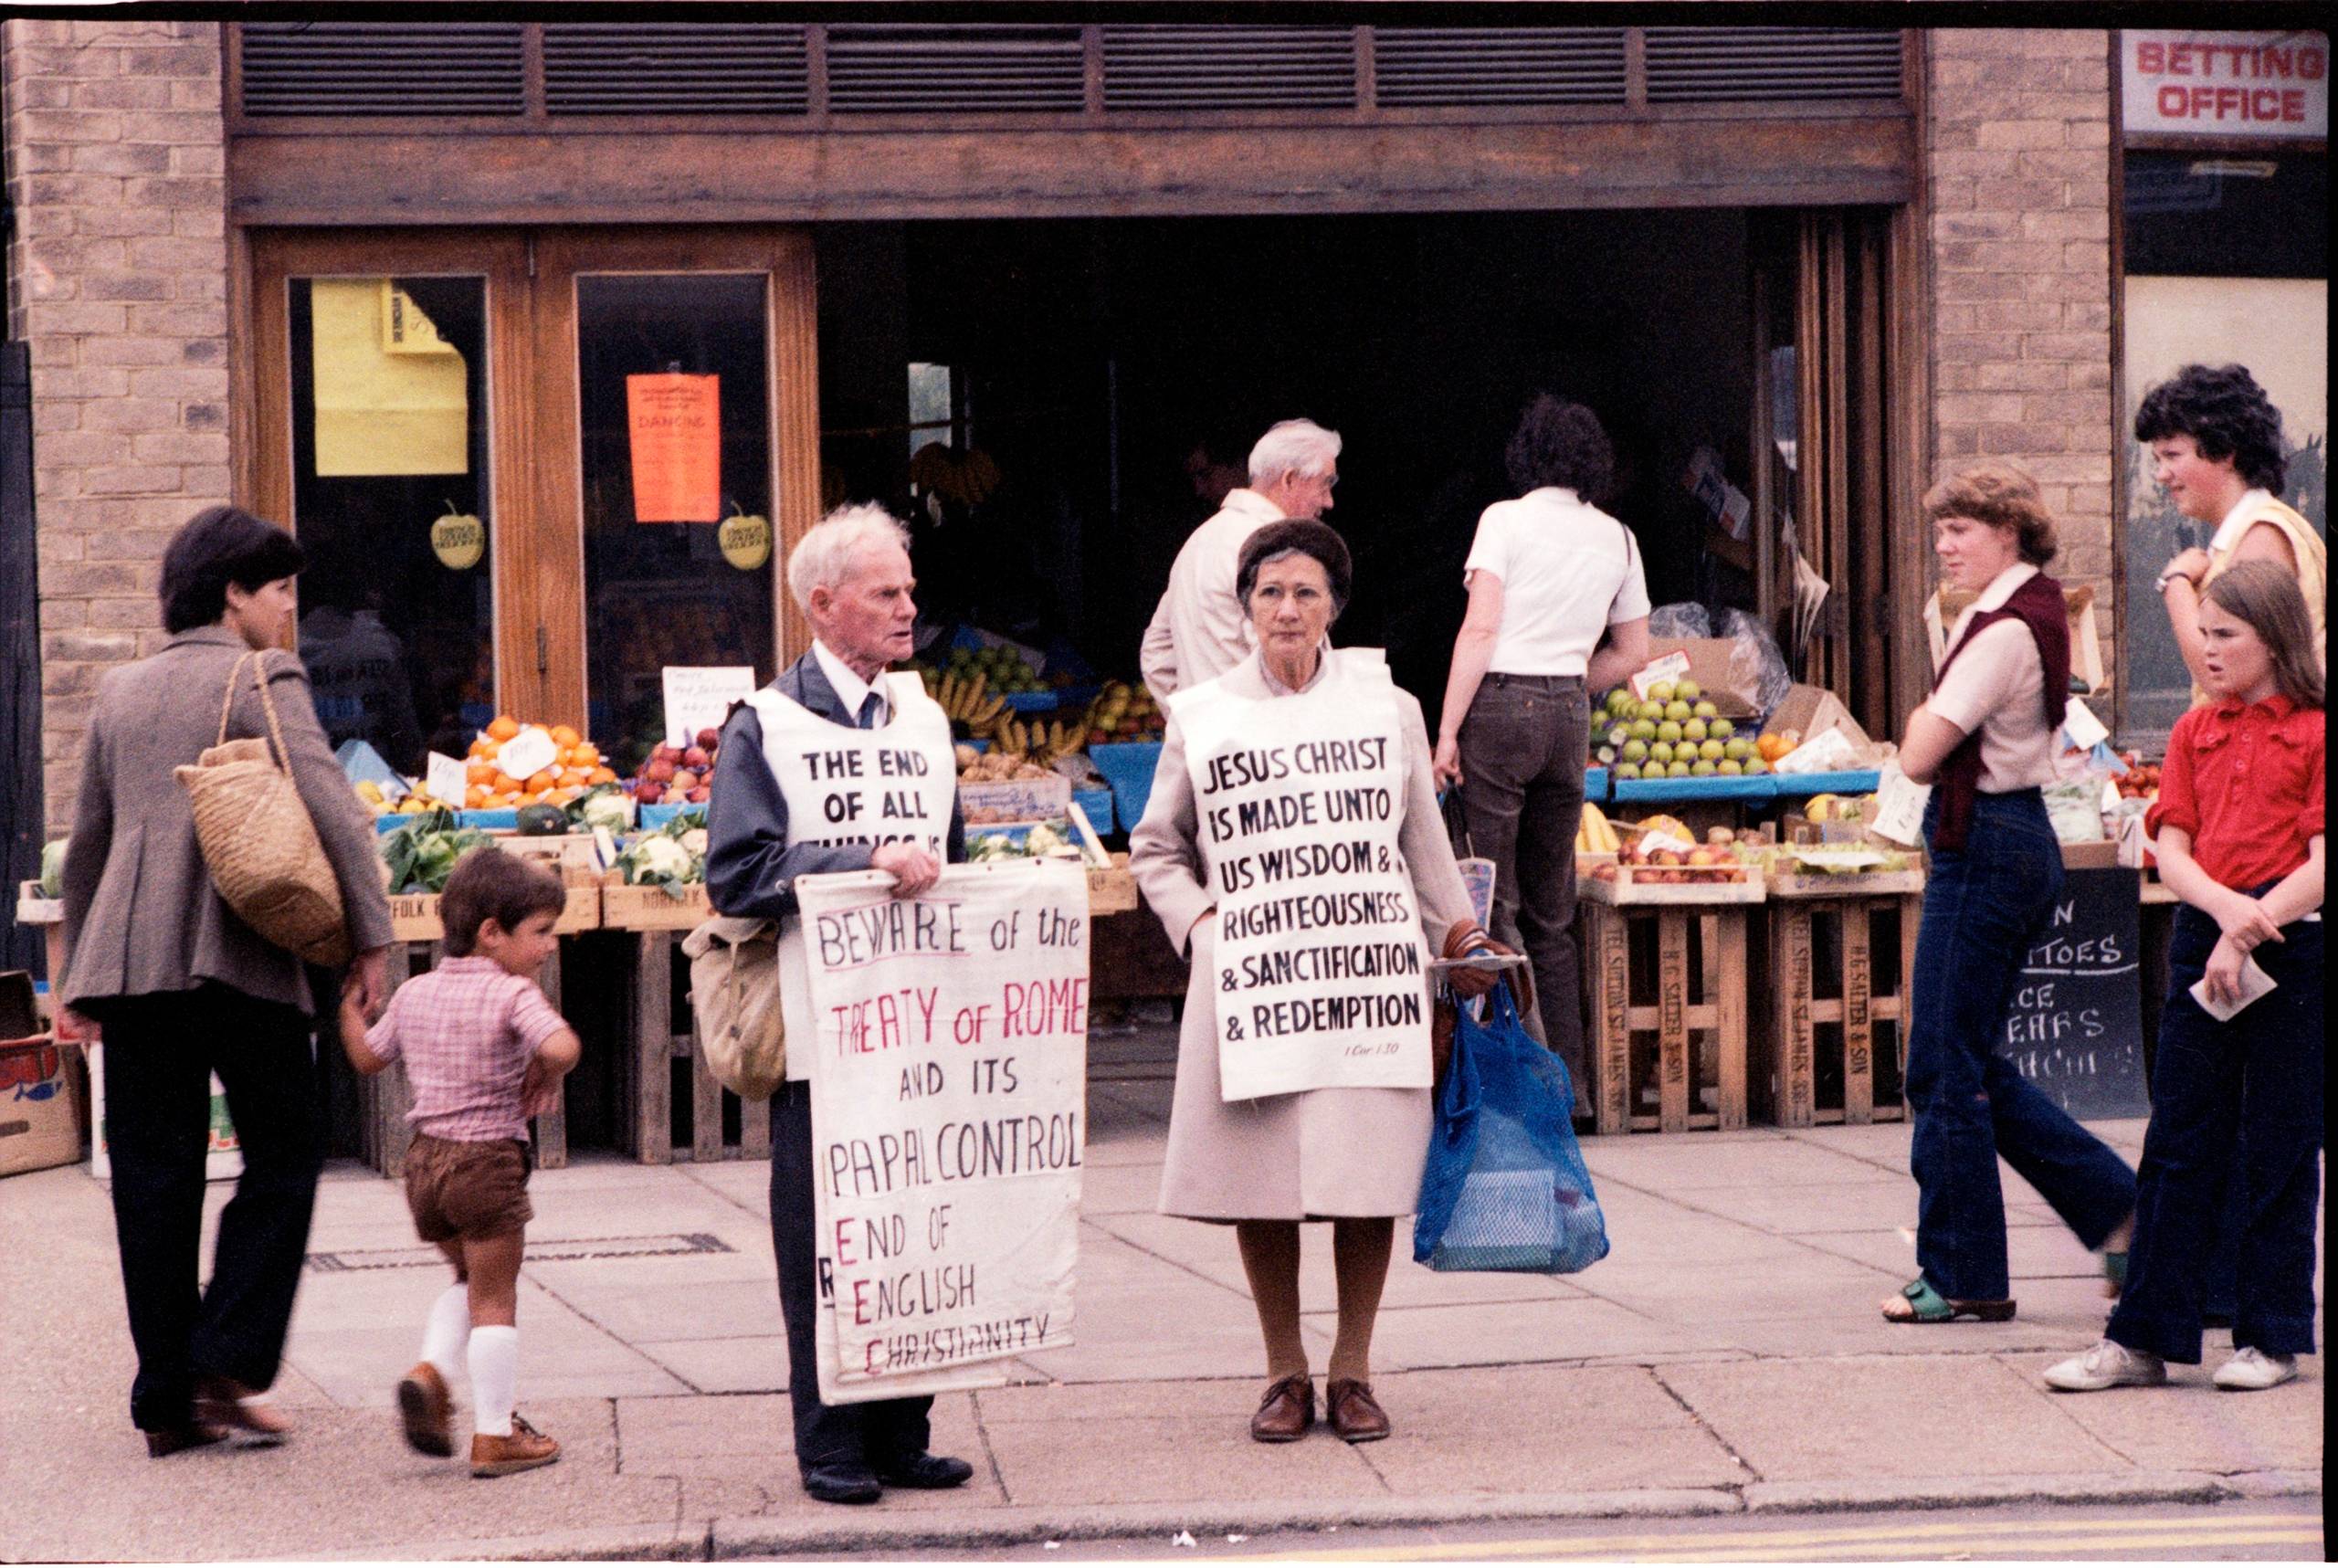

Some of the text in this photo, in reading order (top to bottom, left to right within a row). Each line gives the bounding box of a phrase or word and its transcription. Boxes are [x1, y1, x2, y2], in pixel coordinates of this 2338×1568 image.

[2136, 42, 2326, 80] BETTING
[2157, 85, 2306, 122] OFFICE
[802, 749, 928, 781] THE END
[1203, 737, 1387, 795] JESUS CHRIST
[824, 791, 865, 823] OF
[881, 790, 928, 819] ALL
[1208, 788, 1391, 843] IS MADE UNTO
[1220, 841, 1391, 894] US WISDOM &
[393, 899, 425, 919] FOLK
[817, 901, 1081, 967] BEWARE of the
[1222, 891, 1409, 942] RIGHTEOUSNESS
[2054, 900, 2075, 927] N
[1221, 942, 1420, 993] & SANCTIFICATION
[2027, 933, 2122, 965] TOES
[832, 977, 1088, 1058] TREATY OF ROME
[1226, 993, 1421, 1042] & REDEMPTION
[1849, 972, 1868, 1026] SALTER
[2017, 983, 2055, 1009] CE
[900, 1057, 1017, 1100] AND ITS
[1850, 1047, 1869, 1076] SON
[830, 1112, 1081, 1197] PAPAL CONTROL
[836, 1205, 952, 1266] END OF
[853, 1264, 974, 1325] ENGLISH
[864, 1313, 1049, 1374] CHRISTIANITY
